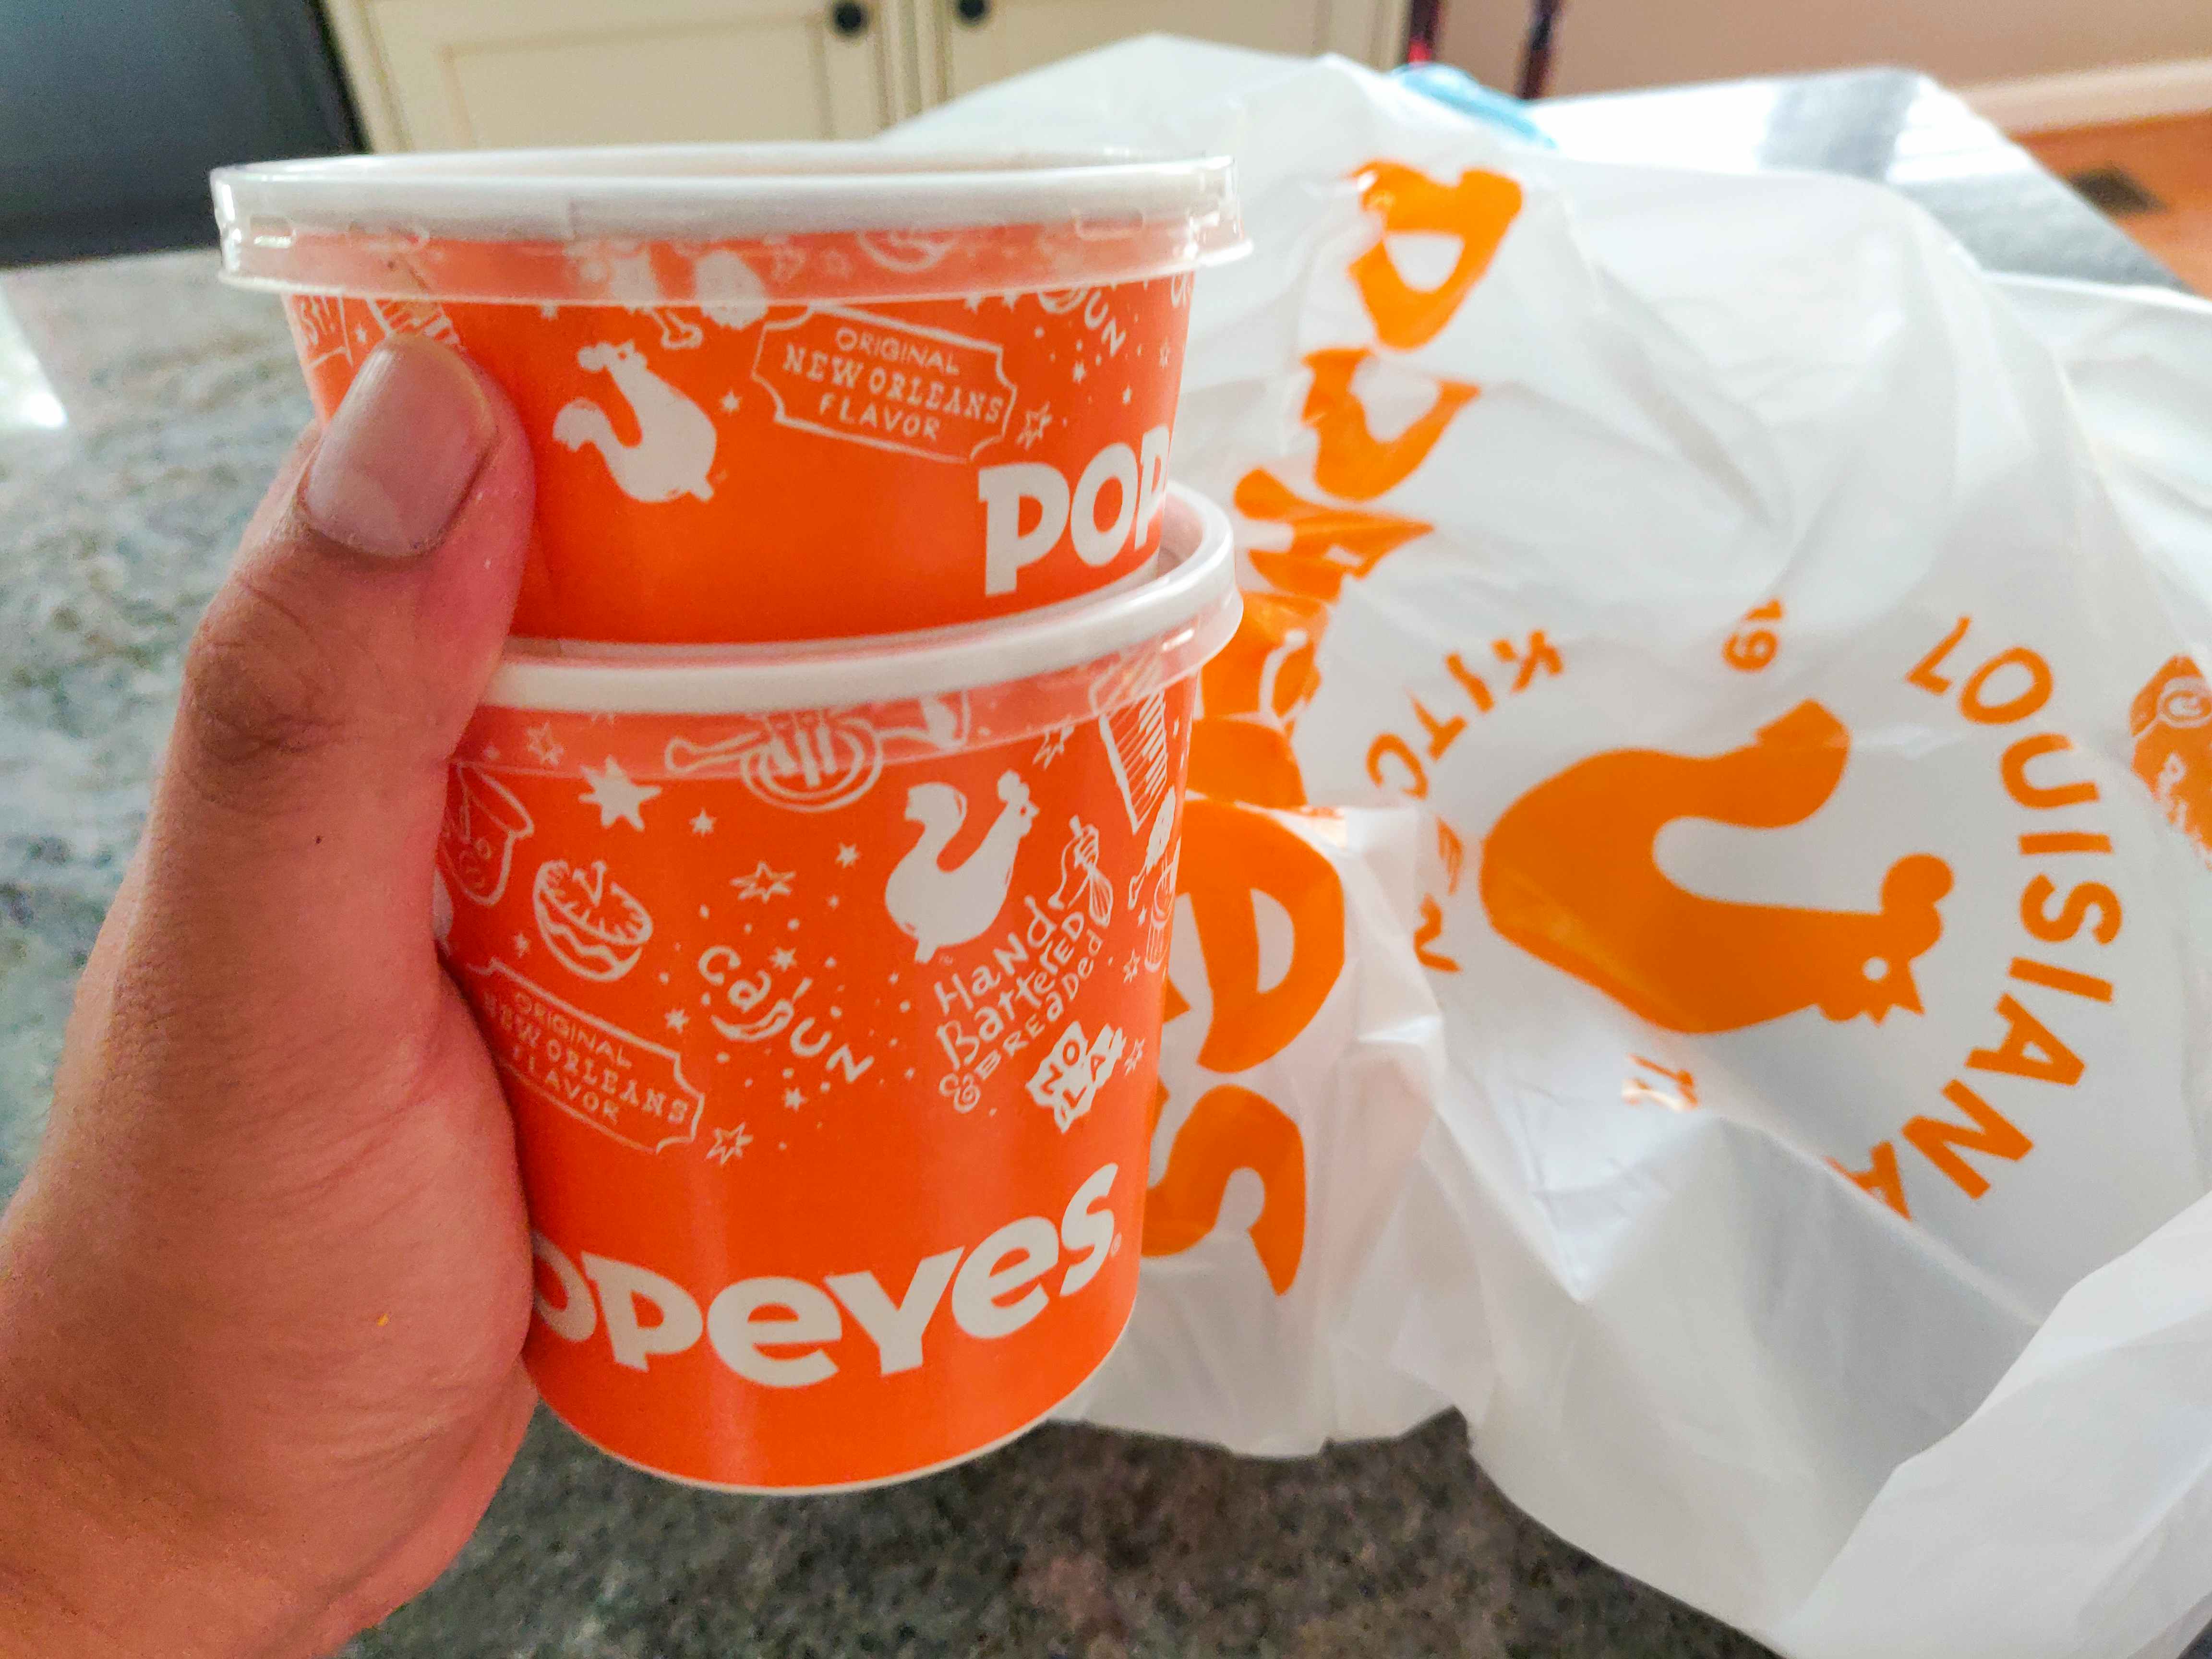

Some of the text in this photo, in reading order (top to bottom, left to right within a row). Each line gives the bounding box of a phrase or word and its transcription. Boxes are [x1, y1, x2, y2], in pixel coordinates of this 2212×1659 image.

[782, 342, 1004, 423] NEW ORLEANS
[835, 326, 960, 376] ORIGINAL
[819, 392, 940, 442] FLAVOR
[1826, 614, 2122, 1221] LOUISIANA
[514, 991, 633, 1070] ORIGINAL
[546, 1038, 688, 1124] ORLEANS
